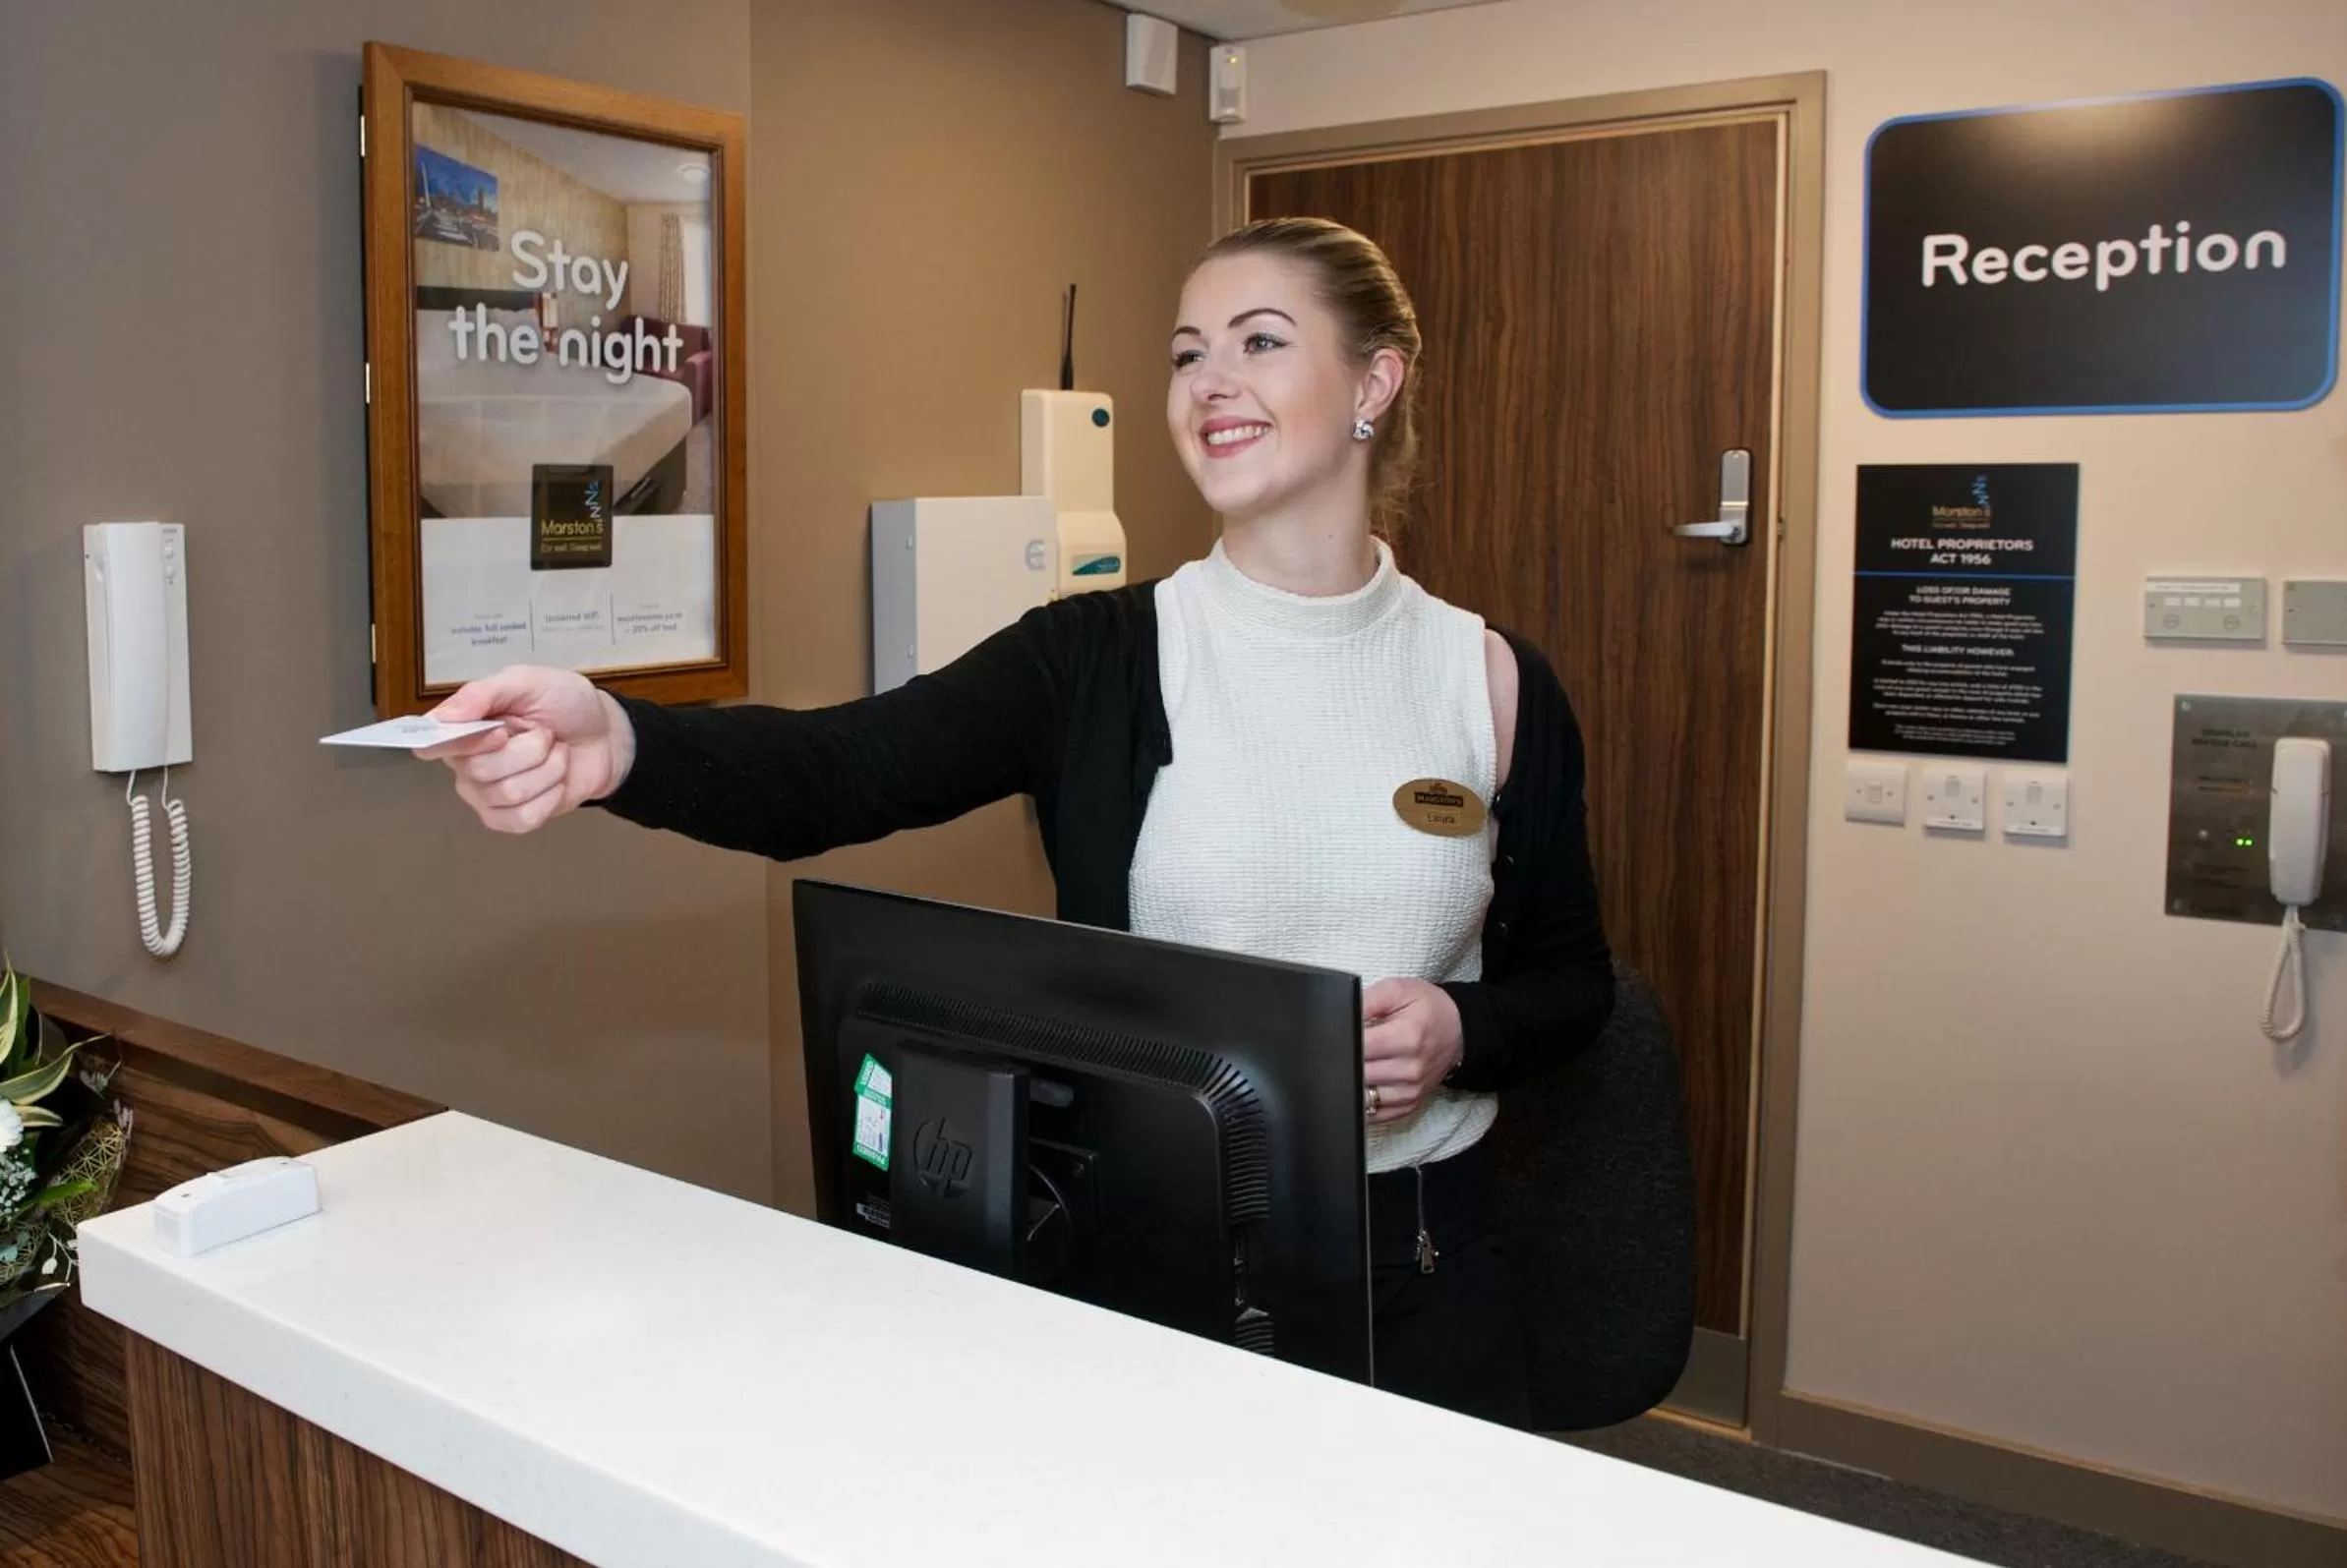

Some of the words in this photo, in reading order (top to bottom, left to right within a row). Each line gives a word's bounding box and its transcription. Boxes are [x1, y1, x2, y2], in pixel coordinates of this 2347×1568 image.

[510, 229, 628, 311] Stay
[1922, 220, 2286, 292] Reception
[447, 302, 540, 365] the
[558, 315, 684, 384] night
[1890, 538, 1934, 550] HOTEL
[1937, 539, 2034, 552] PROPRIETORS
[1930, 552, 1957, 564] ACT
[1961, 553, 1992, 565] 1956
[925, 1116, 974, 1191] hp
